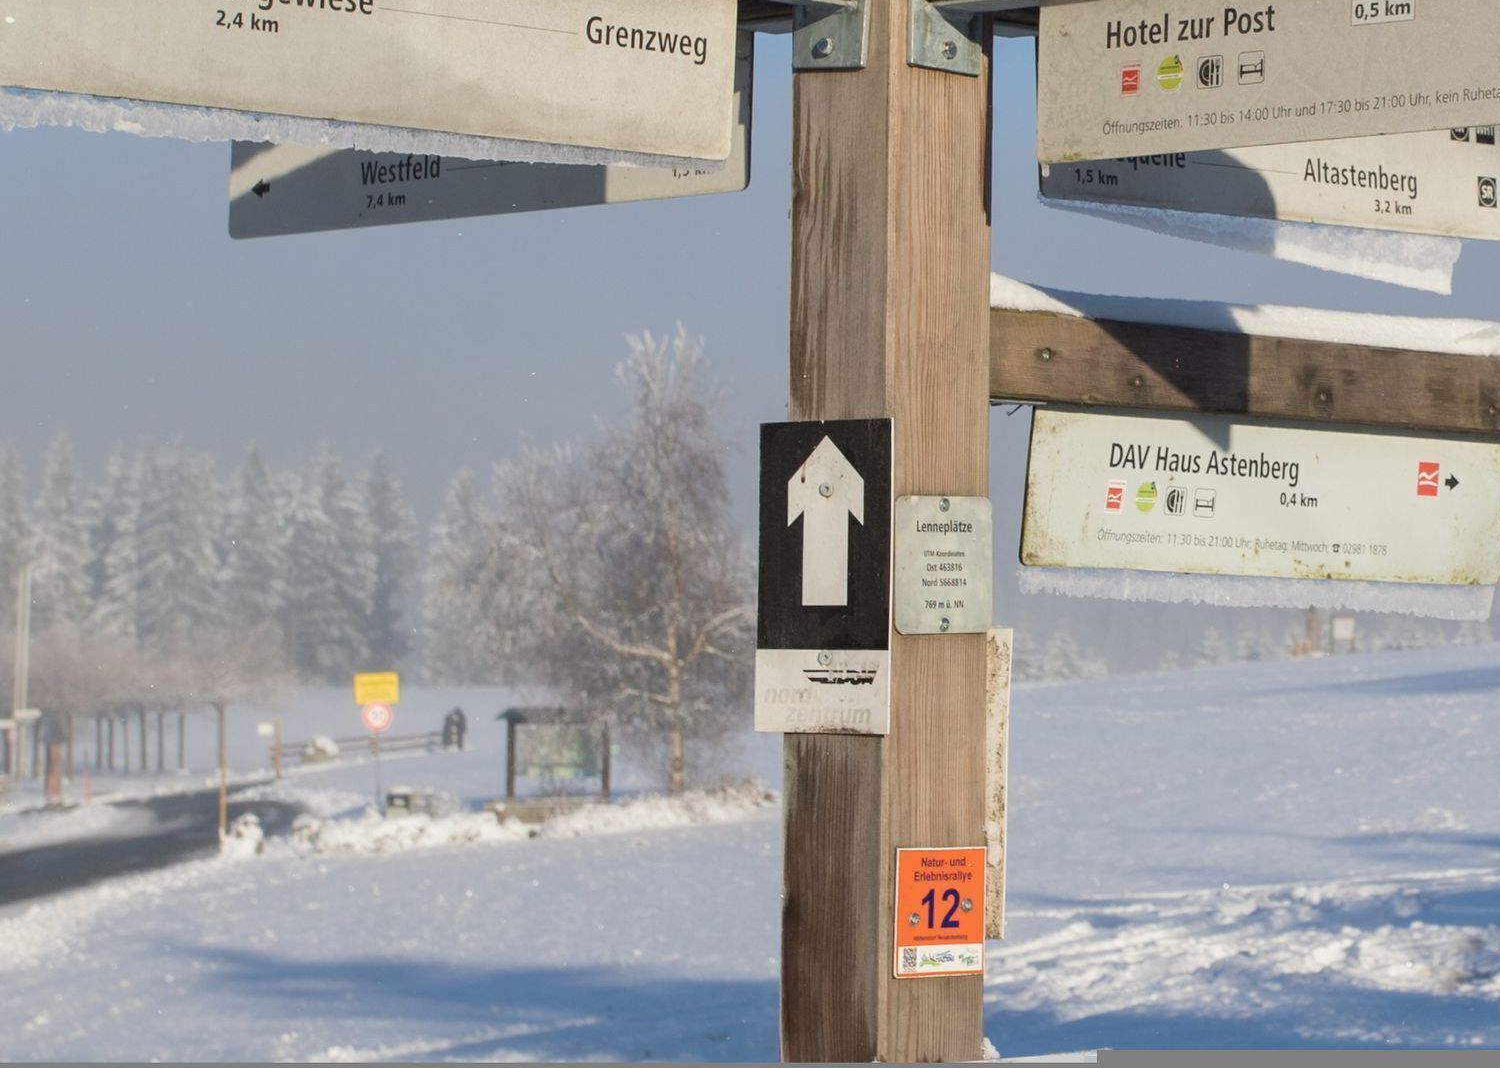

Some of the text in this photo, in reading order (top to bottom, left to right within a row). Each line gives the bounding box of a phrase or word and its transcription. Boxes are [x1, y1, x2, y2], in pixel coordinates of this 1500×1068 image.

[1355, 0, 1411, 20] 0,5 km
[216, 10, 279, 33] 2,4 km
[1106, 5, 1275, 49] Hotel zur Post
[586, 16, 708, 65] Grenzweg
[1102, 116, 1183, 136] Öffnungszeiten:
[1188, 112, 1218, 127] 11:30
[1220, 111, 1235, 124] bis
[1239, 107, 1269, 122] 14:00
[1272, 105, 1292, 119] Uhr
[1295, 102, 1316, 117] und
[1320, 99, 1351, 114] 17:30
[1355, 98, 1370, 112] bis
[1373, 94, 1406, 110] 21:00
[1409, 92, 1431, 107] Uhr,
[1435, 90, 1459, 104] kein
[361, 155, 441, 185] Westfeld
[1074, 168, 1118, 186] 1,5 km
[1303, 158, 1417, 199] Altastenberg
[1481, 184, 1494, 200] SR
[367, 193, 406, 209] 7,4 km
[1374, 199, 1412, 215] 3,2 km
[1109, 443, 1300, 487] DAV Haus Astenberg
[1280, 492, 1318, 508] 0,4 km
[916, 520, 973, 535] Lenneplätze
[1167, 533, 1192, 547] 11:30
[1194, 534, 1206, 547] bis
[1208, 535, 1233, 548] 21:00
[926, 563, 937, 572] Ost
[922, 578, 938, 587] Nord
[921, 857, 966, 867] Natur- und
[914, 871, 973, 883] Erlebnisrallye
[921, 888, 961, 929] 12
